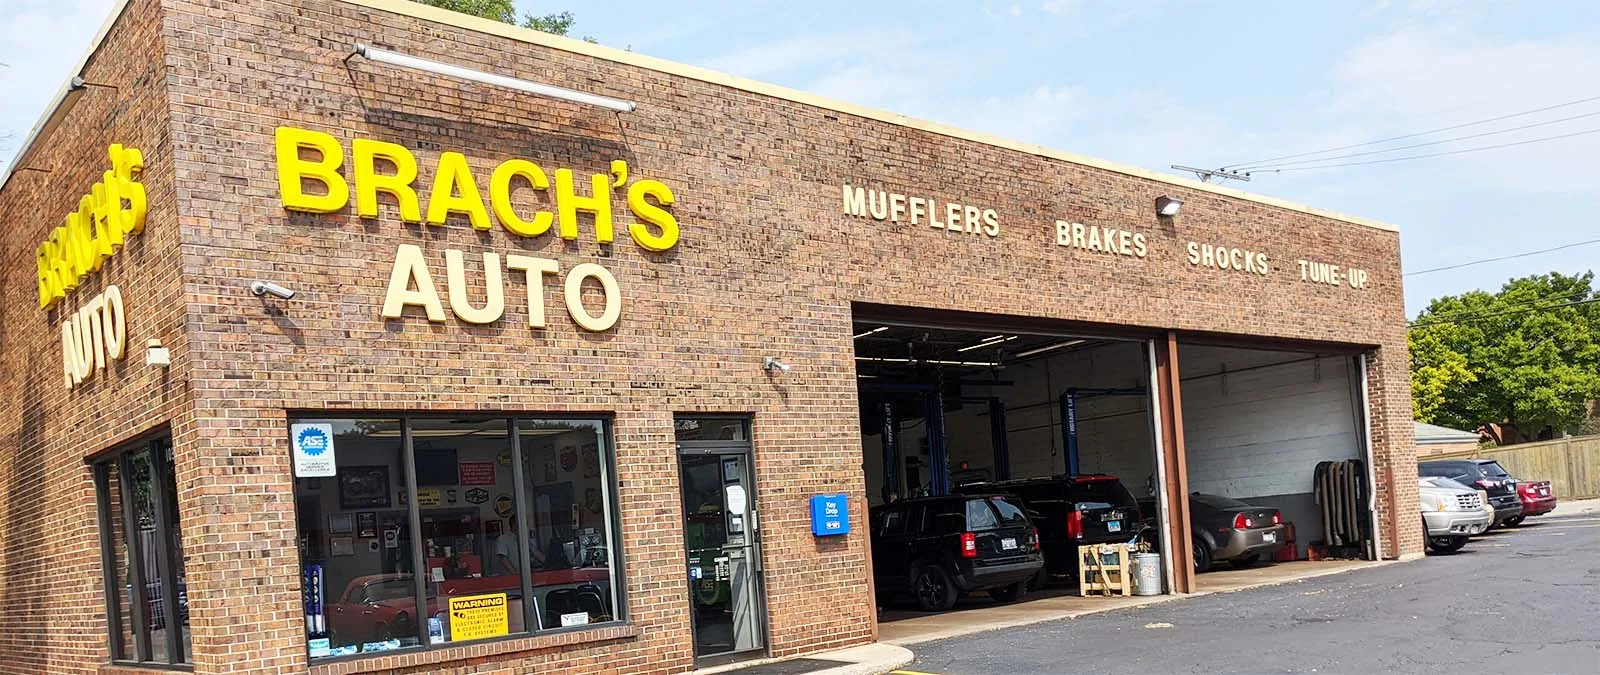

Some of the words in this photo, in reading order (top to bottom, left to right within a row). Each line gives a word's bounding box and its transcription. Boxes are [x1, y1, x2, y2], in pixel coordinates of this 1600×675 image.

[36, 143, 147, 311] BRACH'S
[275, 126, 681, 252] BRACH'S
[842, 184, 1000, 238] MUFFLERS
[1056, 219, 1148, 258] BRAKES
[1187, 241, 1269, 276] SHOCKS
[1298, 259, 1368, 290] TUNE-UP
[382, 243, 622, 332] AUTO
[62, 284, 126, 389] AUTO
[302, 435, 324, 446] ASE
[825, 501, 837, 509] Key
[825, 508, 839, 516] Drop
[453, 598, 503, 610] WARNING
